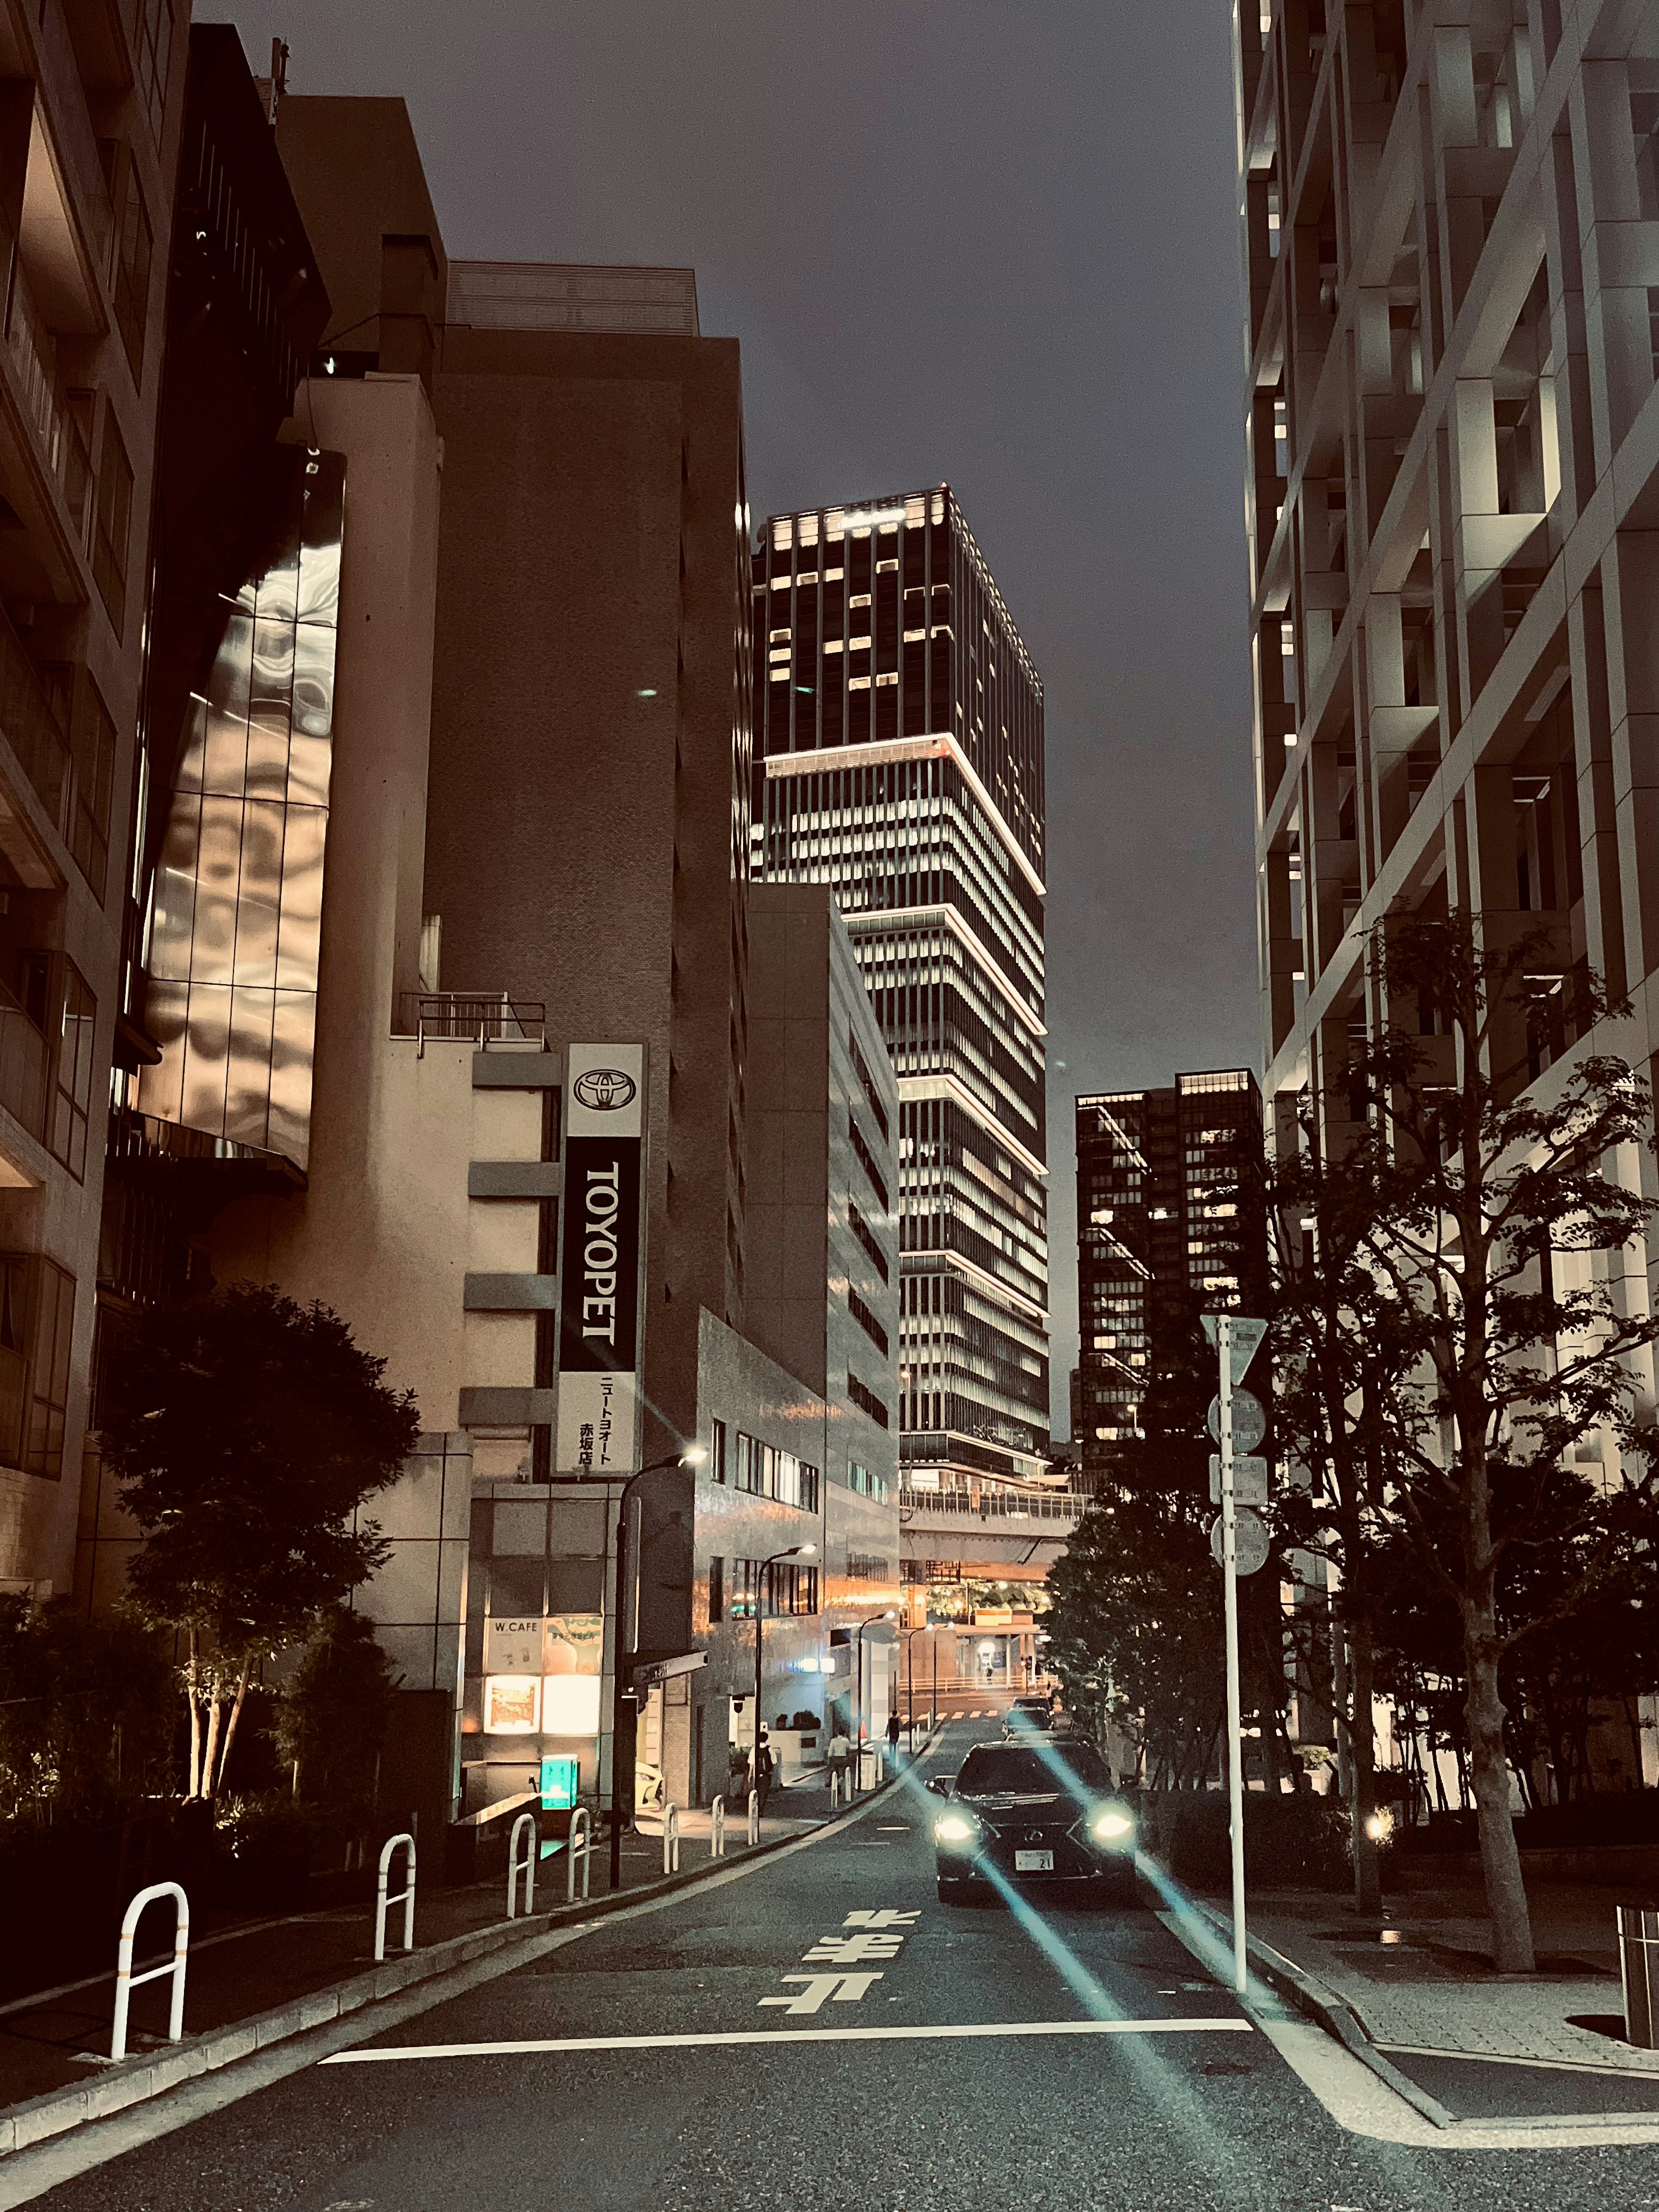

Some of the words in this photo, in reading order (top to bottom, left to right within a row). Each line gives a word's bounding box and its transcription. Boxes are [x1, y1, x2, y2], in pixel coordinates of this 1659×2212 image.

[583, 1161, 619, 1346] TOYOPET
[579, 1423, 594, 1465] 赤坂店
[599, 1377, 613, 1465] ニュートヨオート
[1040, 1858, 1050, 1869] 21
[757, 1909, 922, 2014] 止まれ
